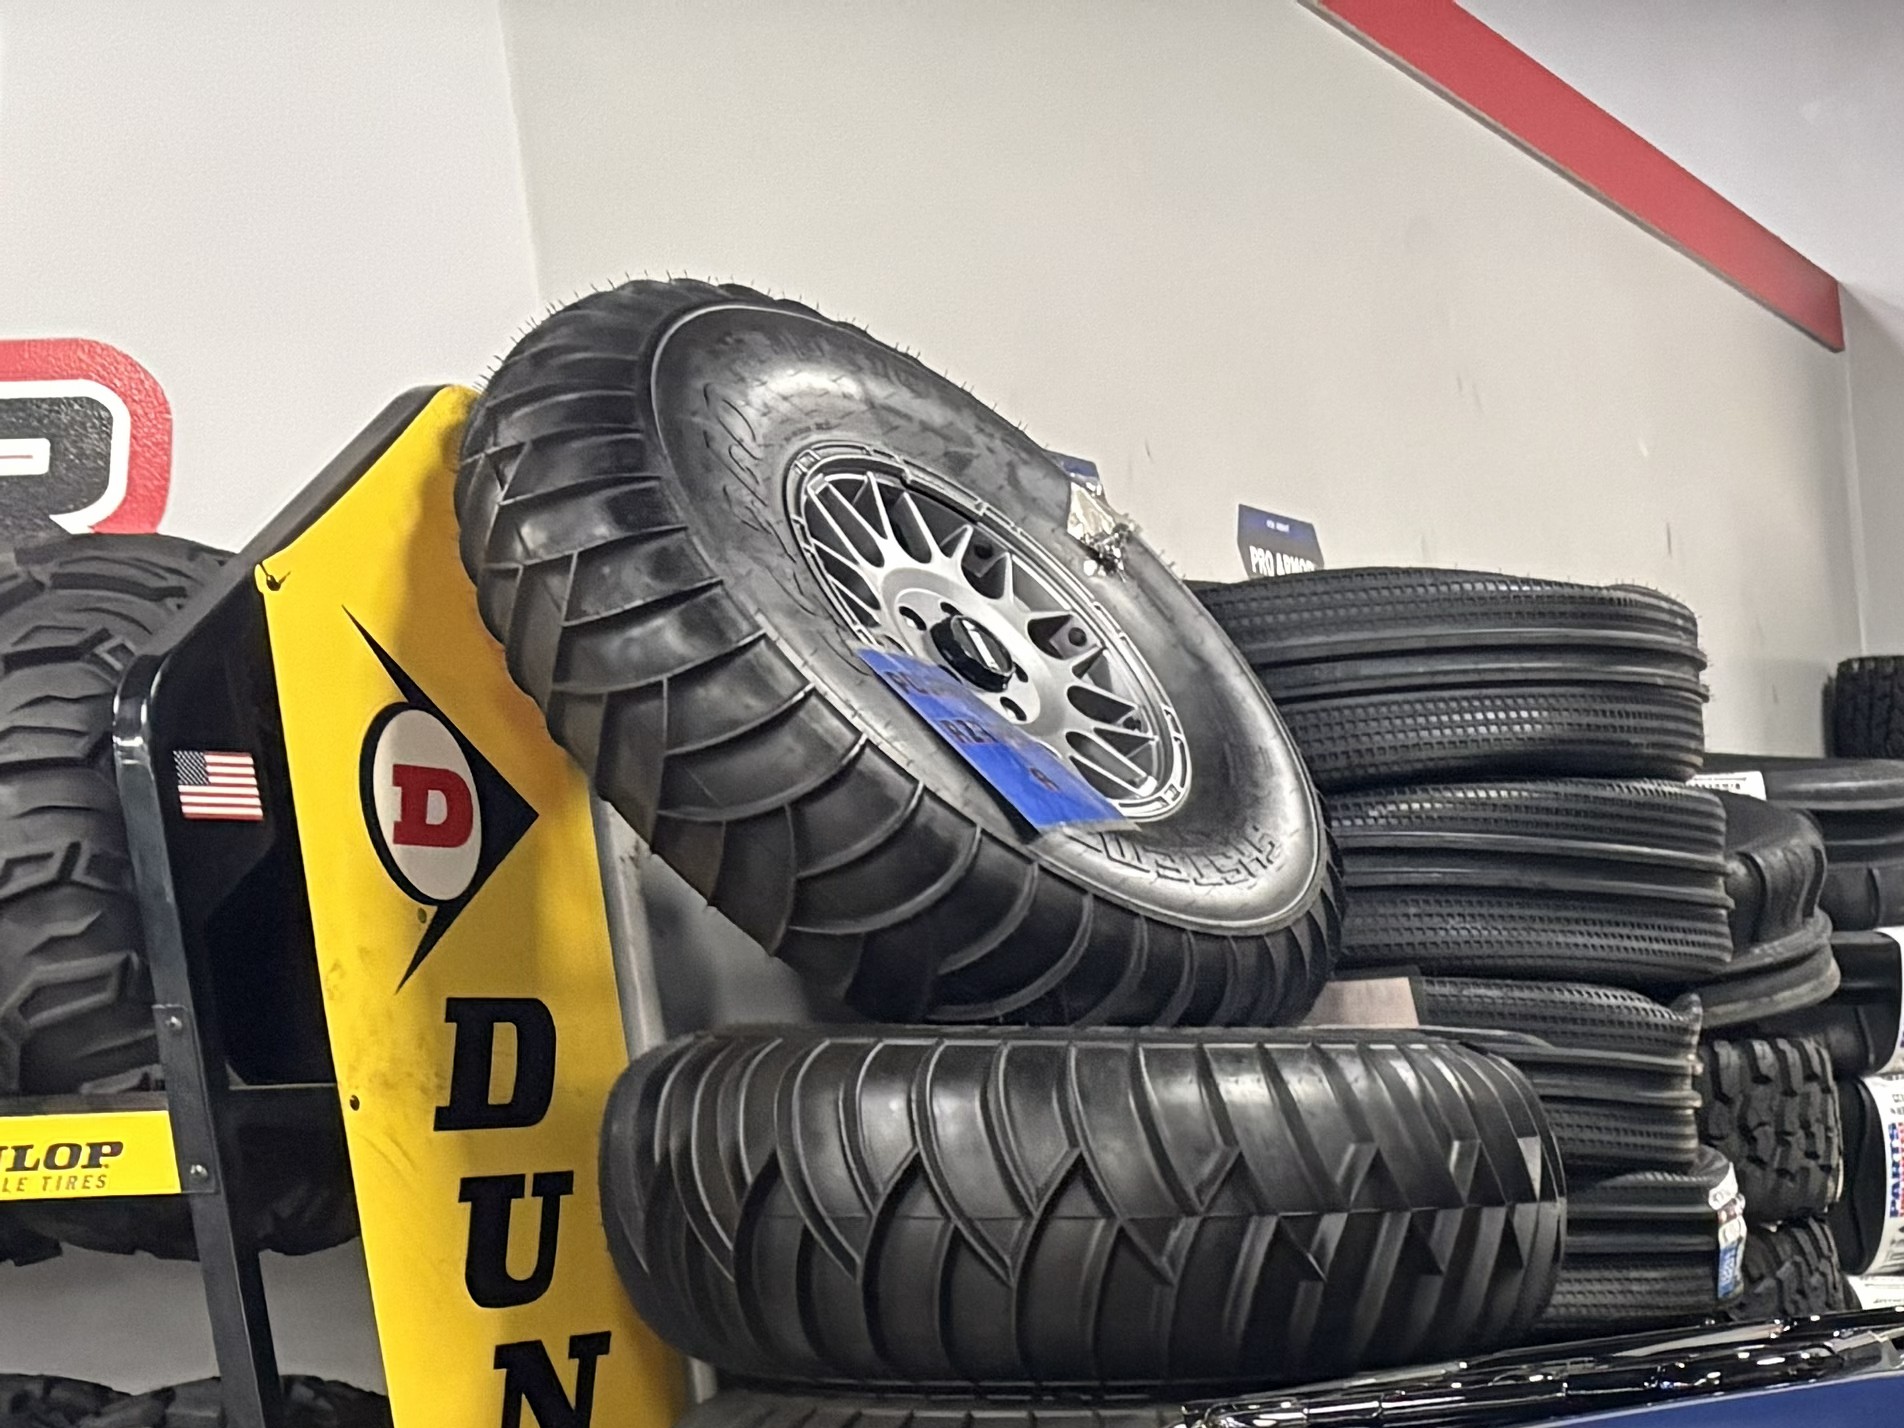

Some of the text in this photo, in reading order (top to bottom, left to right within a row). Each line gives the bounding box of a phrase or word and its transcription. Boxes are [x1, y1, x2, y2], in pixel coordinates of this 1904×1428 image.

[1249, 545, 1275, 577] PRO
[390, 763, 474, 847] D
[42, 1174, 107, 1191] TIRES
[1888, 1122, 1901, 1219] PARTS
